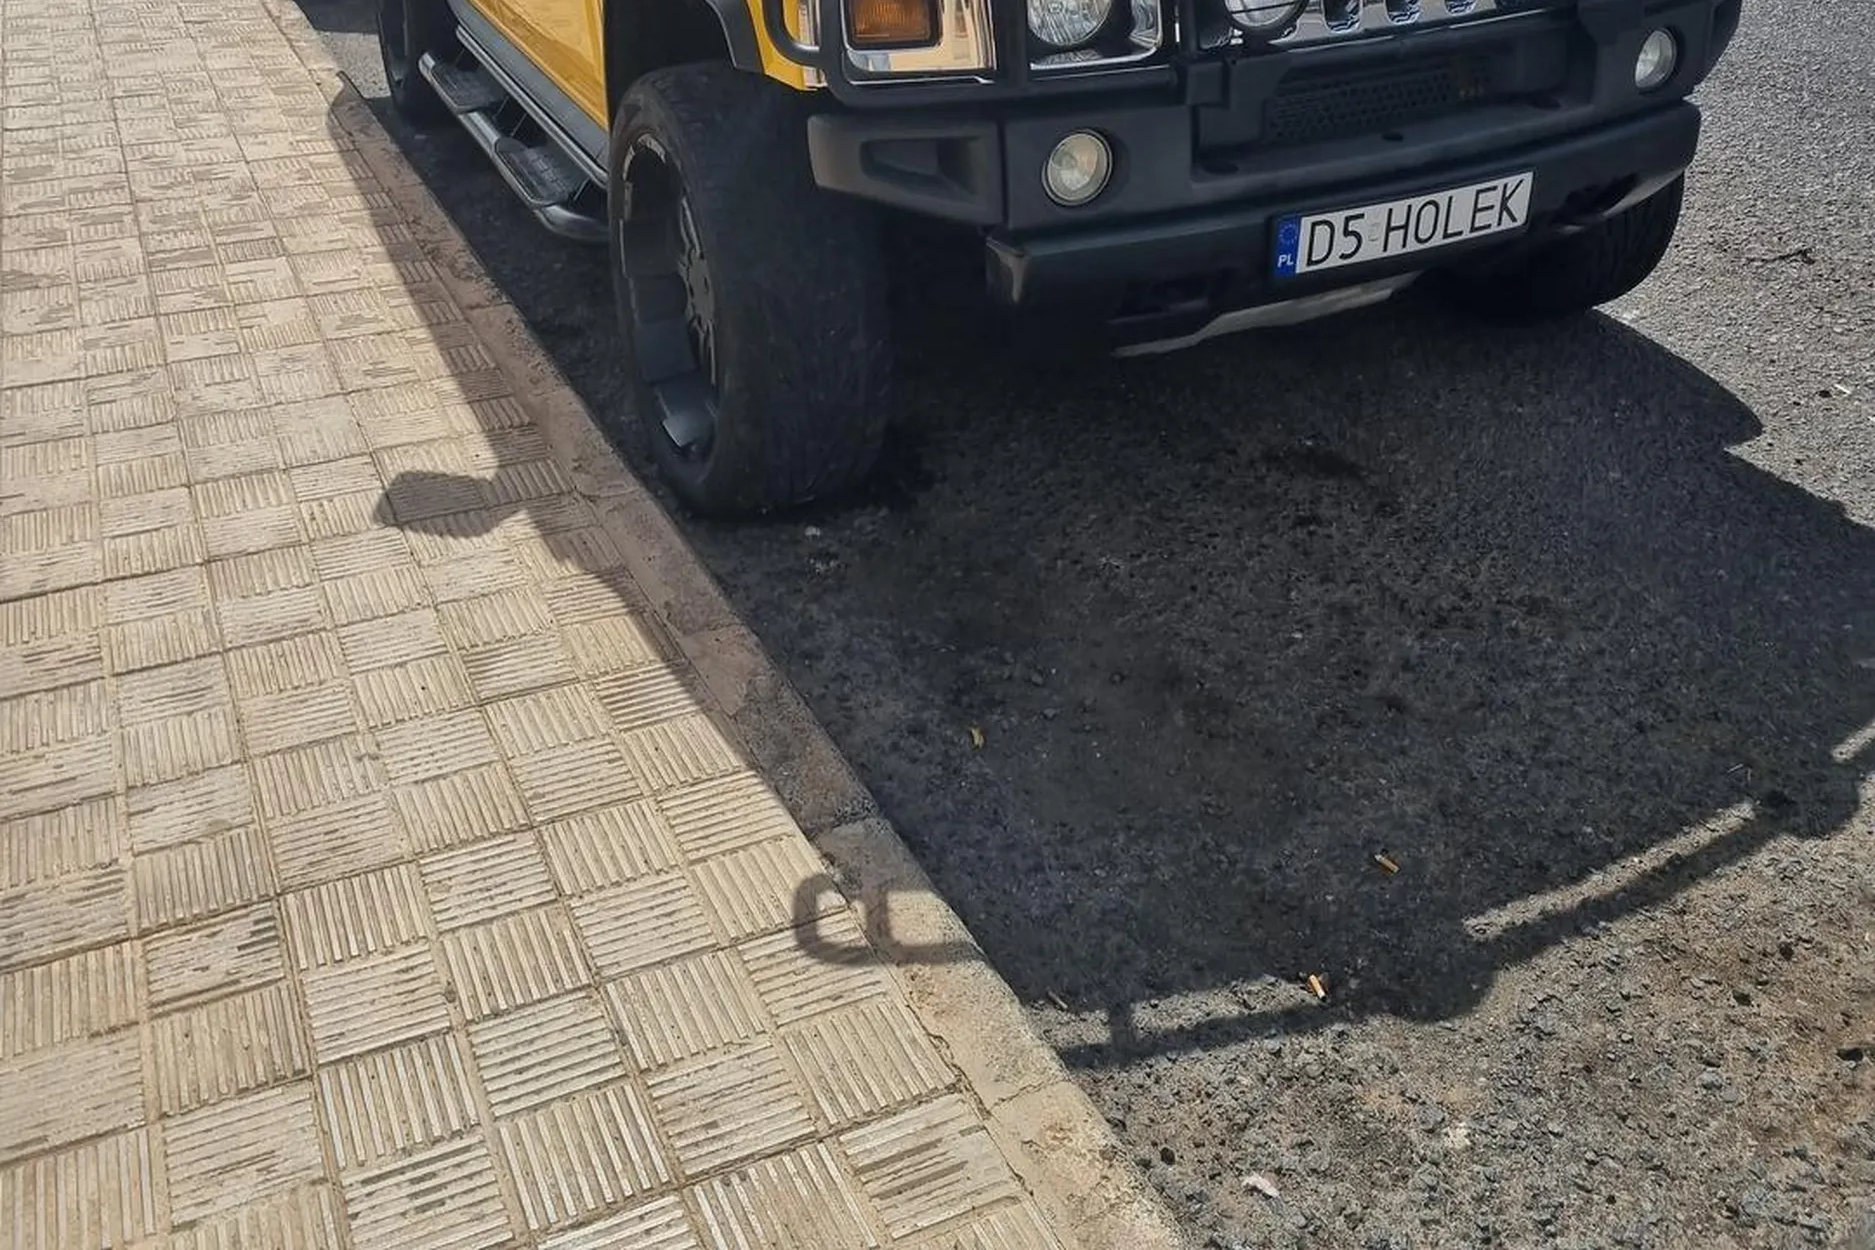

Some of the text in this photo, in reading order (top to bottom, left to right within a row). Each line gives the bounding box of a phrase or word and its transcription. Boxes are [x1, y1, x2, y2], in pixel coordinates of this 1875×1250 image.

[1306, 179, 1525, 267] D5 HOLEK
[1277, 253, 1294, 268] PL
